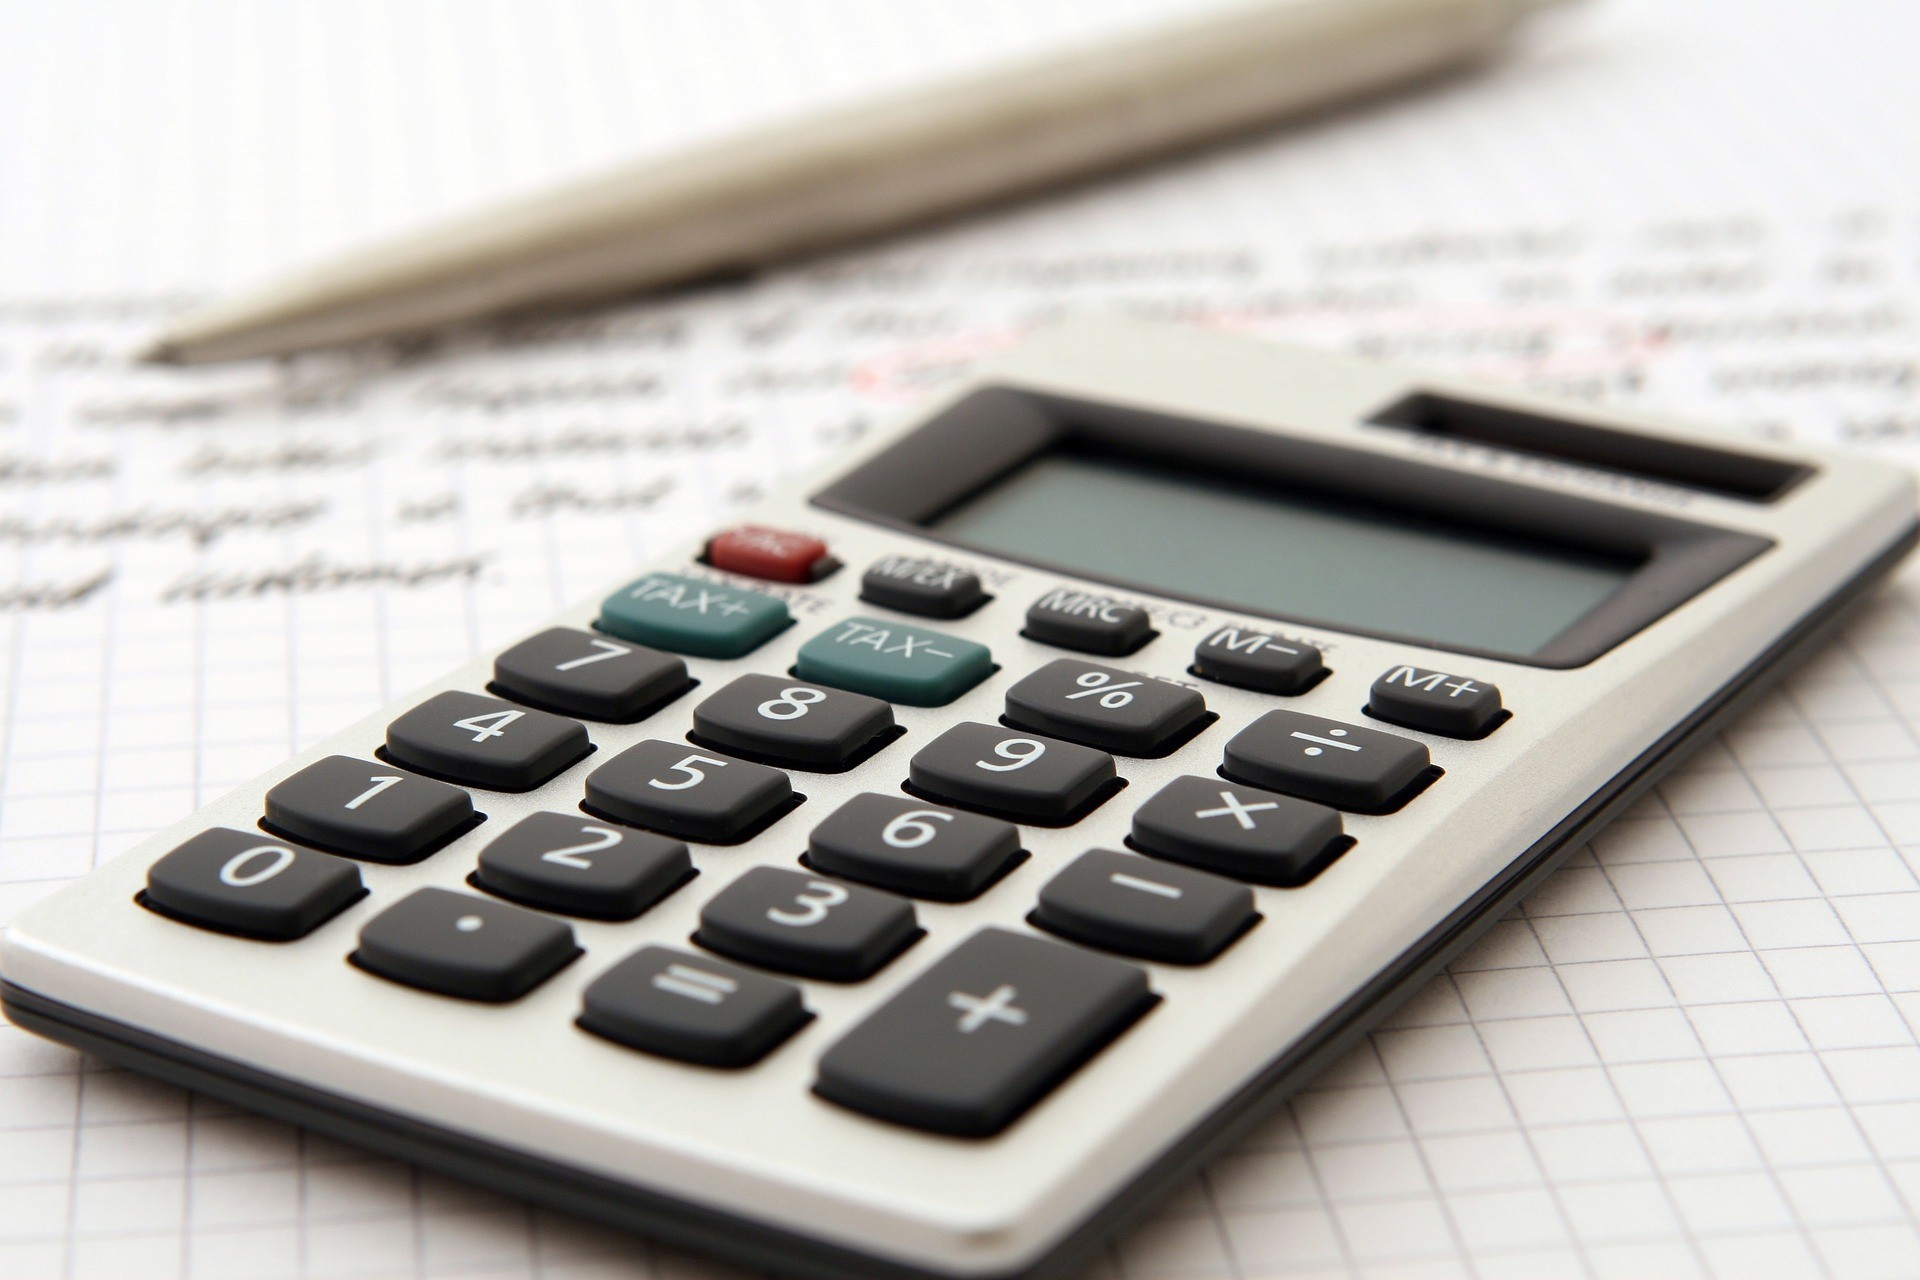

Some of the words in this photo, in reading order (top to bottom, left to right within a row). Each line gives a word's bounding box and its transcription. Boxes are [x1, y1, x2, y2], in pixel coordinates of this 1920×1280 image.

[629, 577, 751, 618] TAX+
[1039, 589, 1130, 625] MRC
[555, 638, 632, 672] 7
[832, 621, 955, 660] TAX-
[1208, 626, 1299, 656] M-
[1065, 671, 1145, 710] %
[1386, 665, 1480, 698] M+
[757, 687, 827, 721] 8
[452, 709, 527, 744] 4
[648, 754, 729, 790] 5
[975, 738, 1046, 773] 9
[344, 775, 404, 811] 1
[541, 825, 623, 870] 2
[882, 809, 954, 849] 6
[218, 844, 296, 888] 0
[767, 880, 849, 927] 3
[652, 962, 738, 1005] =
[948, 984, 1029, 1034] +
